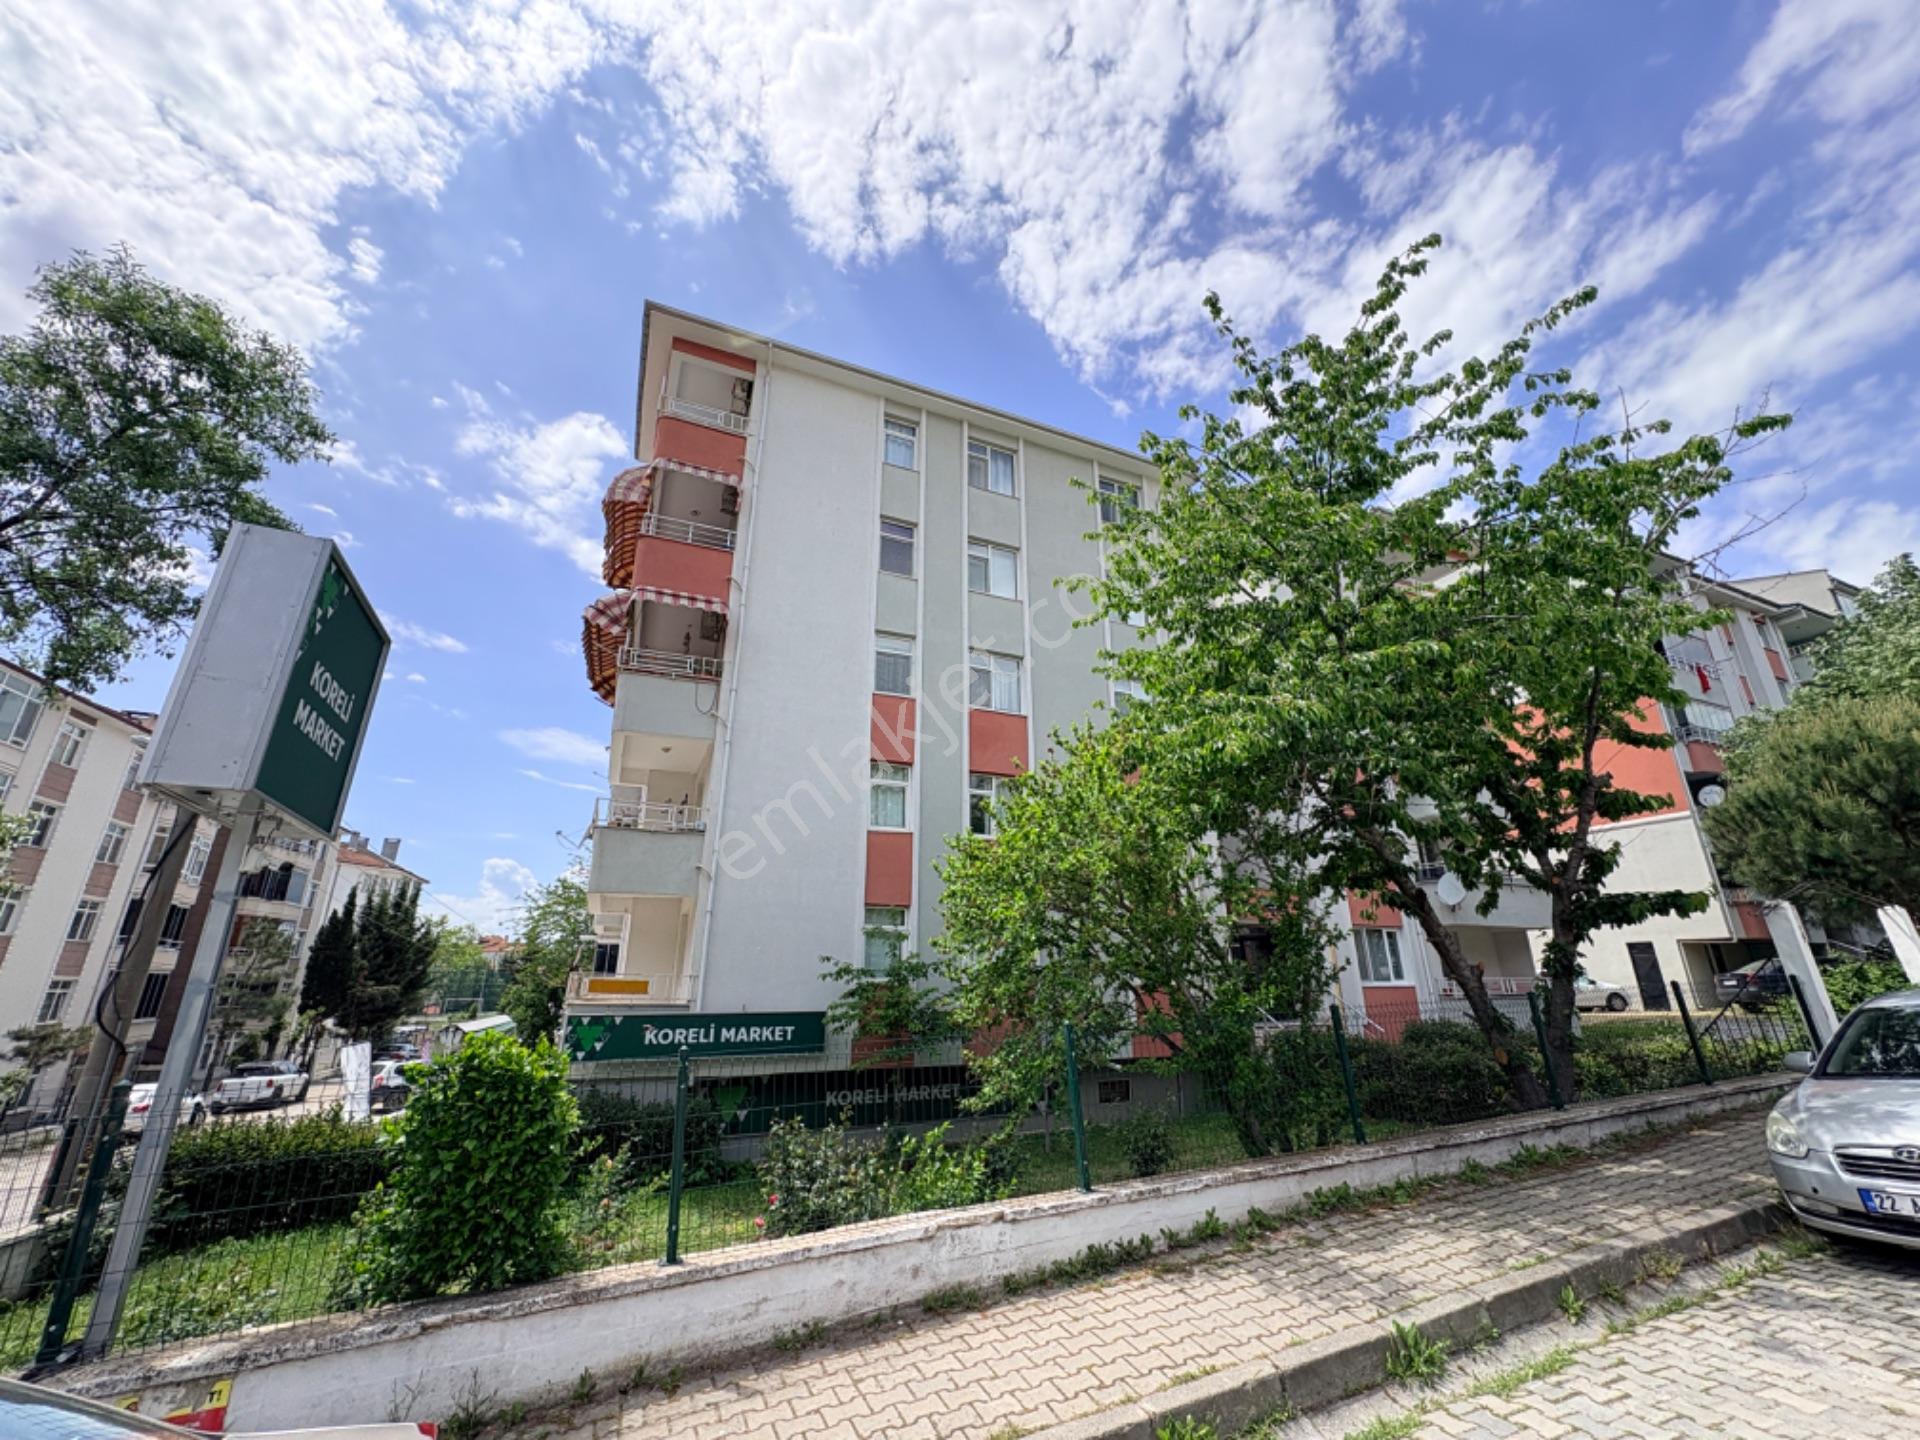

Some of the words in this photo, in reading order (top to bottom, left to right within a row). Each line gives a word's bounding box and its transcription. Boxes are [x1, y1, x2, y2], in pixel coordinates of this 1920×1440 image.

[310, 660, 355, 723] KORELİ
[293, 698, 346, 762] MARKET
[644, 1023, 716, 1045] KORELİ
[720, 1026, 795, 1043] MARKET
[893, 1083, 961, 1103] MARKET
[1874, 1193, 1900, 1212] 22
